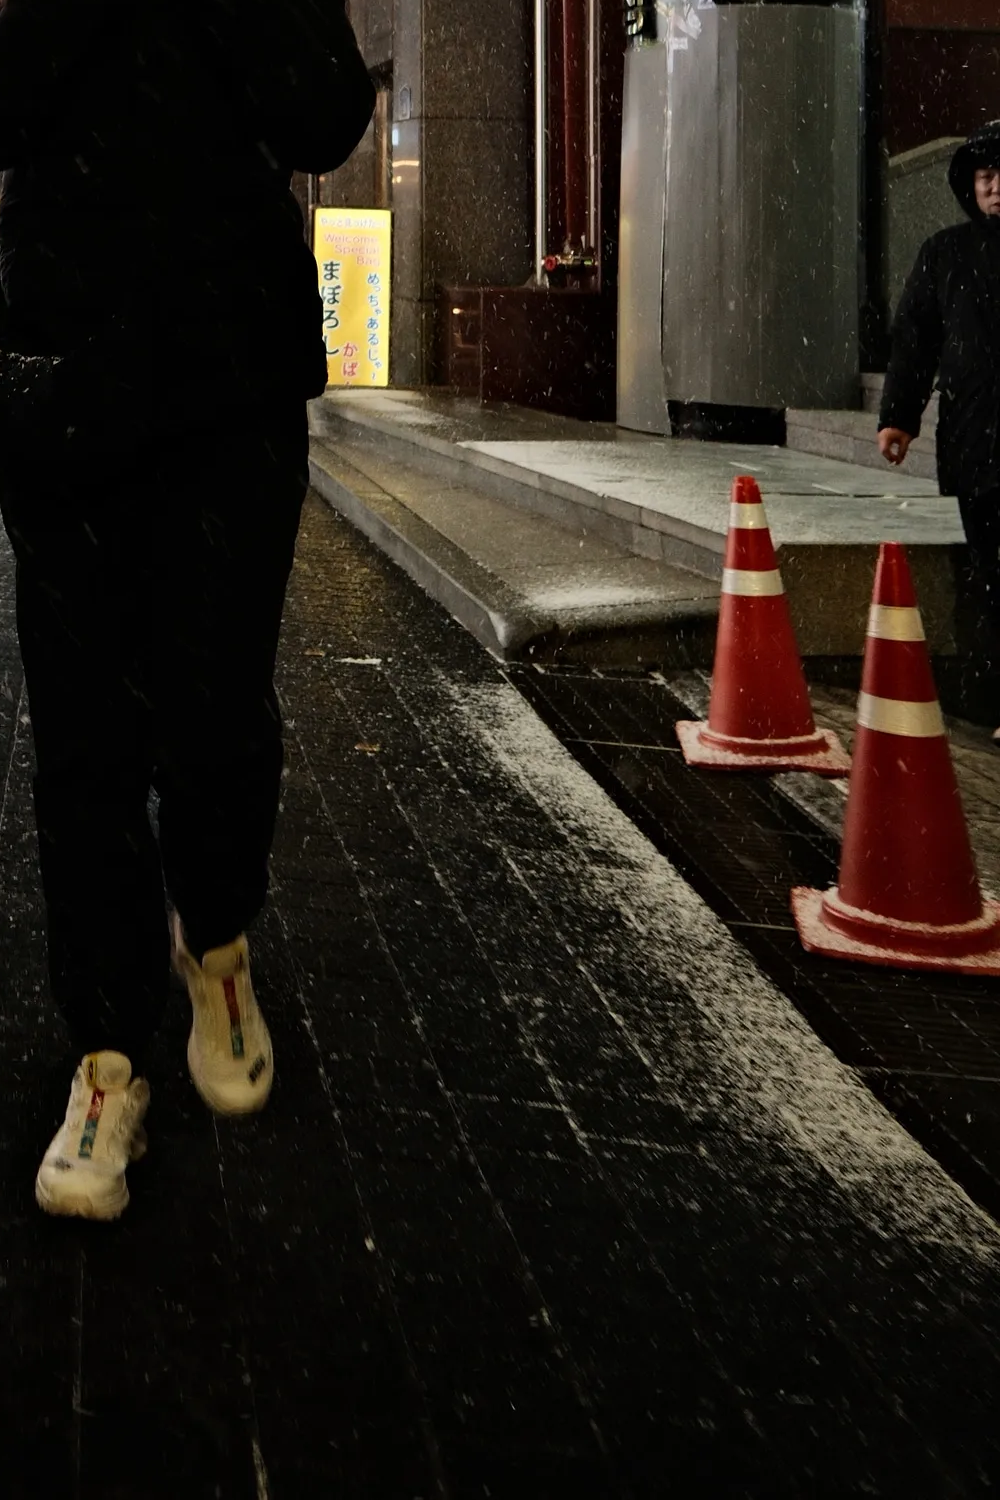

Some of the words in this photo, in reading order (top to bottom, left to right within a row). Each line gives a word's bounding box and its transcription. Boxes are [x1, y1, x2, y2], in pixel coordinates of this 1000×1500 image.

[323, 233, 379, 244] Welcome
[334, 244, 380, 255] Special
[342, 342, 358, 386] かば
